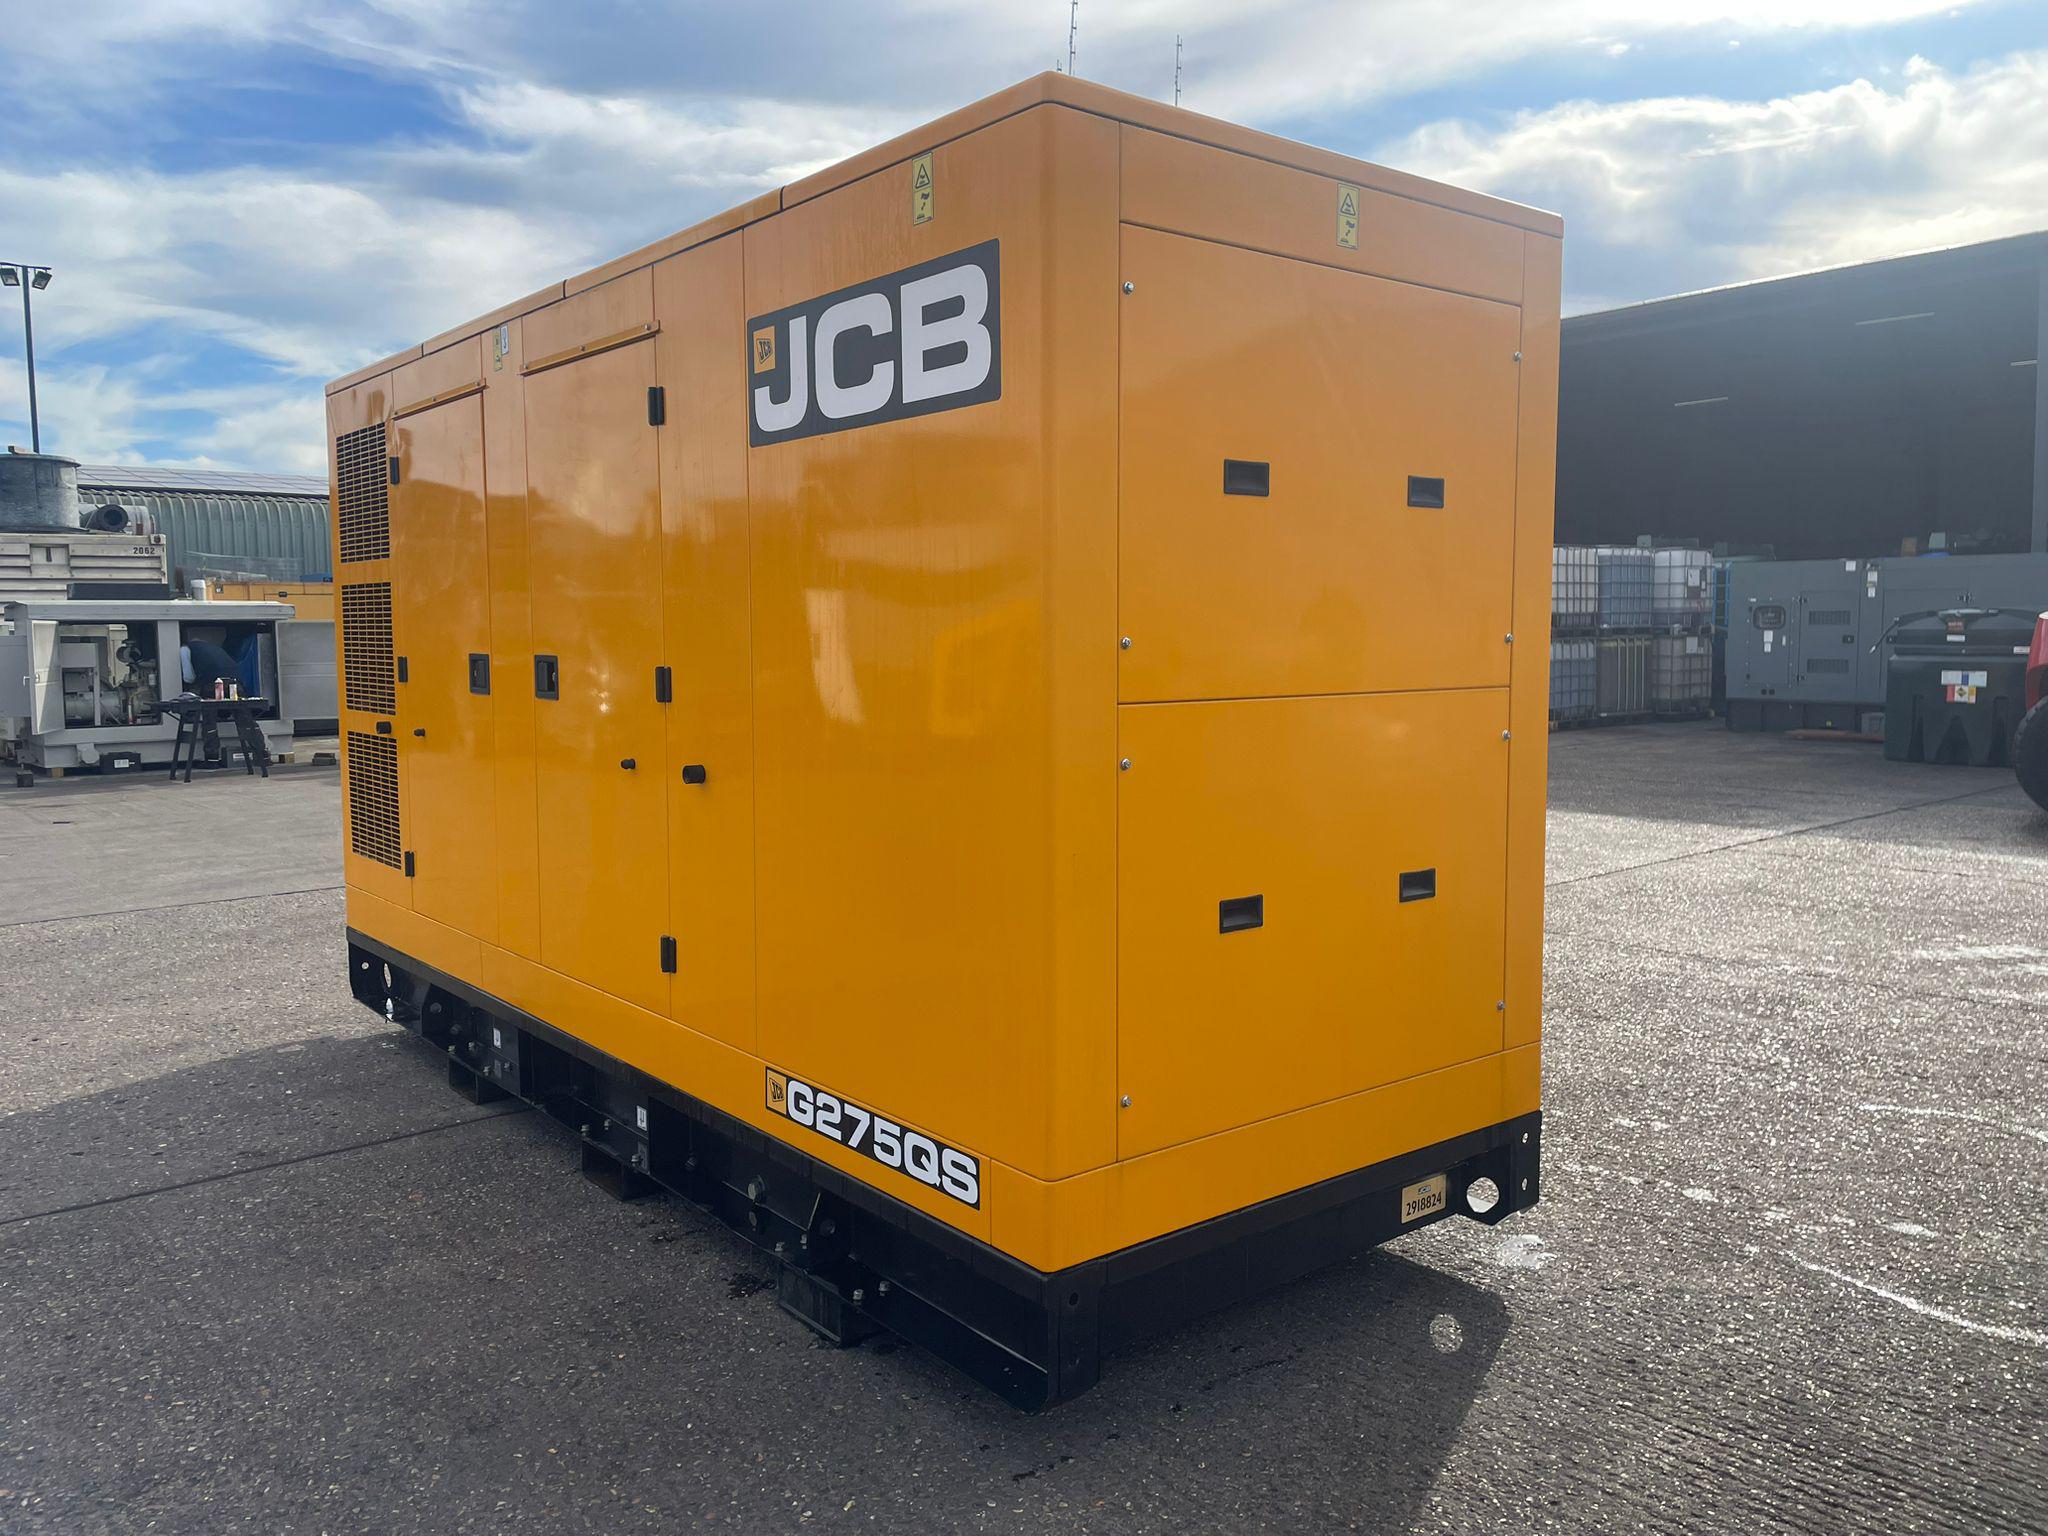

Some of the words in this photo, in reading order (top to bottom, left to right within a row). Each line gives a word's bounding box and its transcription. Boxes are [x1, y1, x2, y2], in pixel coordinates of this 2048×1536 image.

[754, 264, 992, 432] JCB
[132, 546, 155, 555] 2062
[787, 1080, 979, 1205] G275QS
[1406, 1191, 1442, 1216] 2918824
